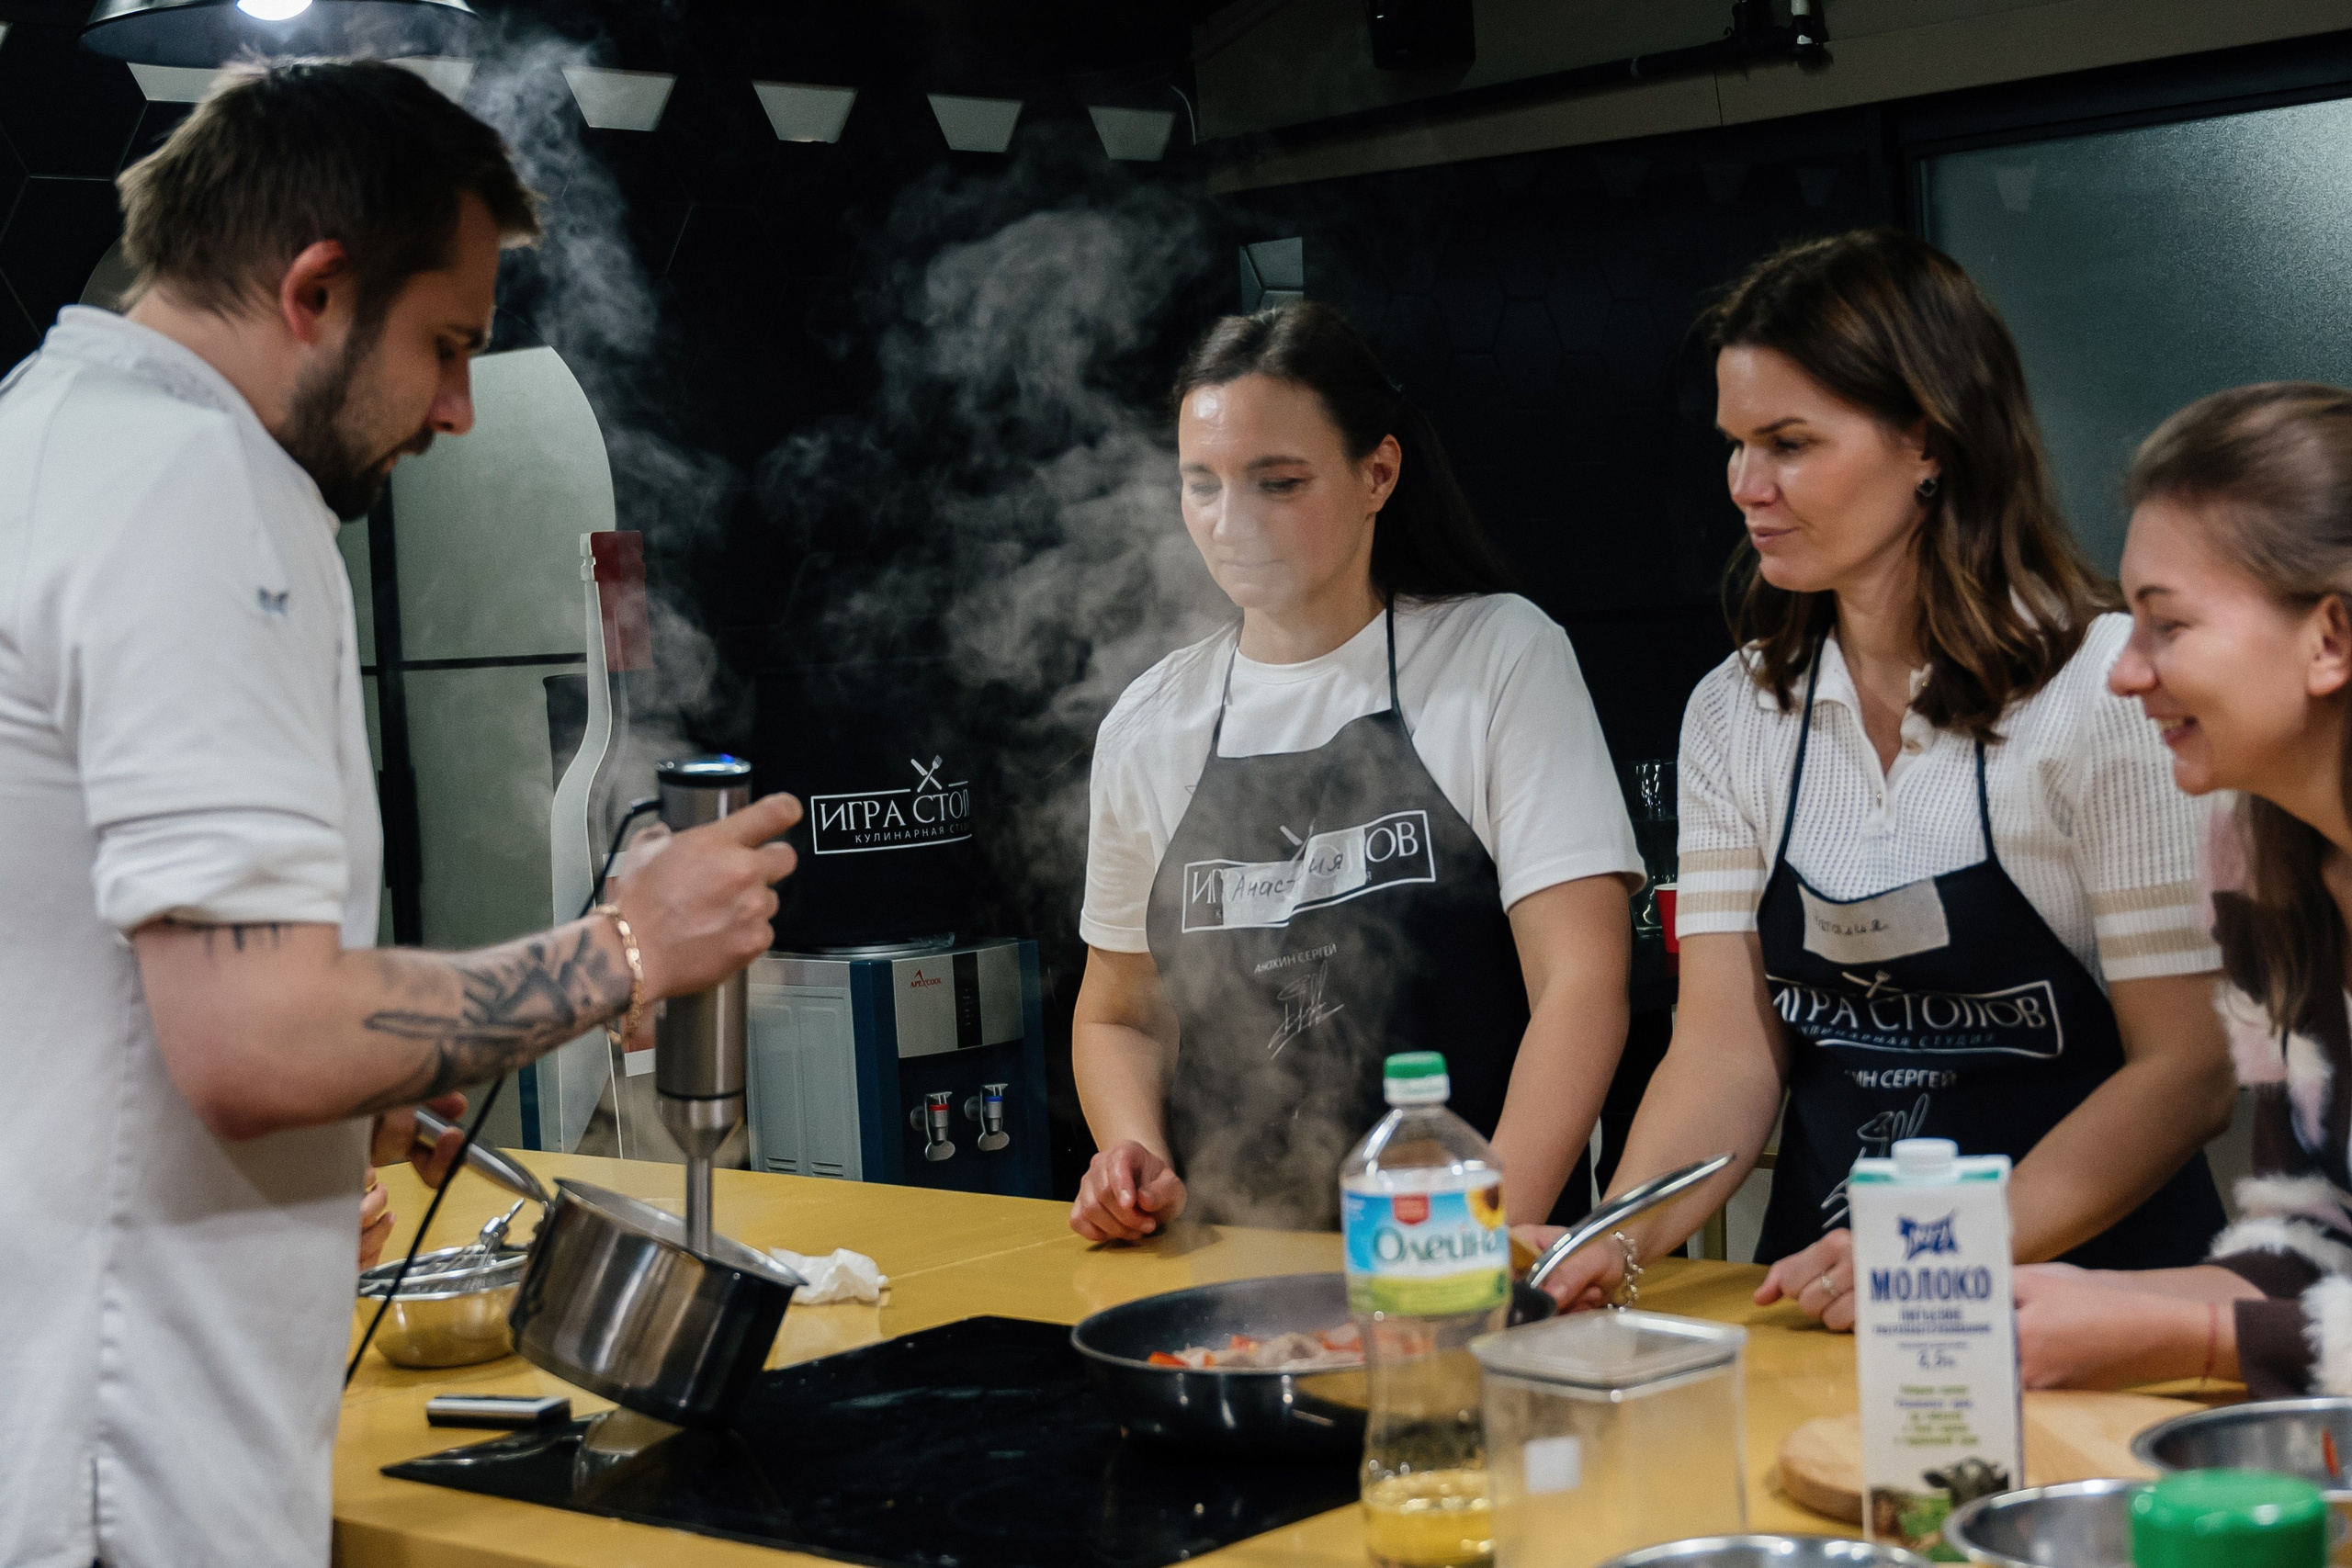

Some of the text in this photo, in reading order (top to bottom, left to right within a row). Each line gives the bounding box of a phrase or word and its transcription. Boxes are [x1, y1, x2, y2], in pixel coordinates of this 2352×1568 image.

[820, 788, 970, 831] ИГРА СТОЛ
[854, 826, 944, 844] КУЛИНАРНАЯ
[1192, 868, 1223, 905] ИГ
[1871, 1267, 1992, 1302] МОЛОКО
